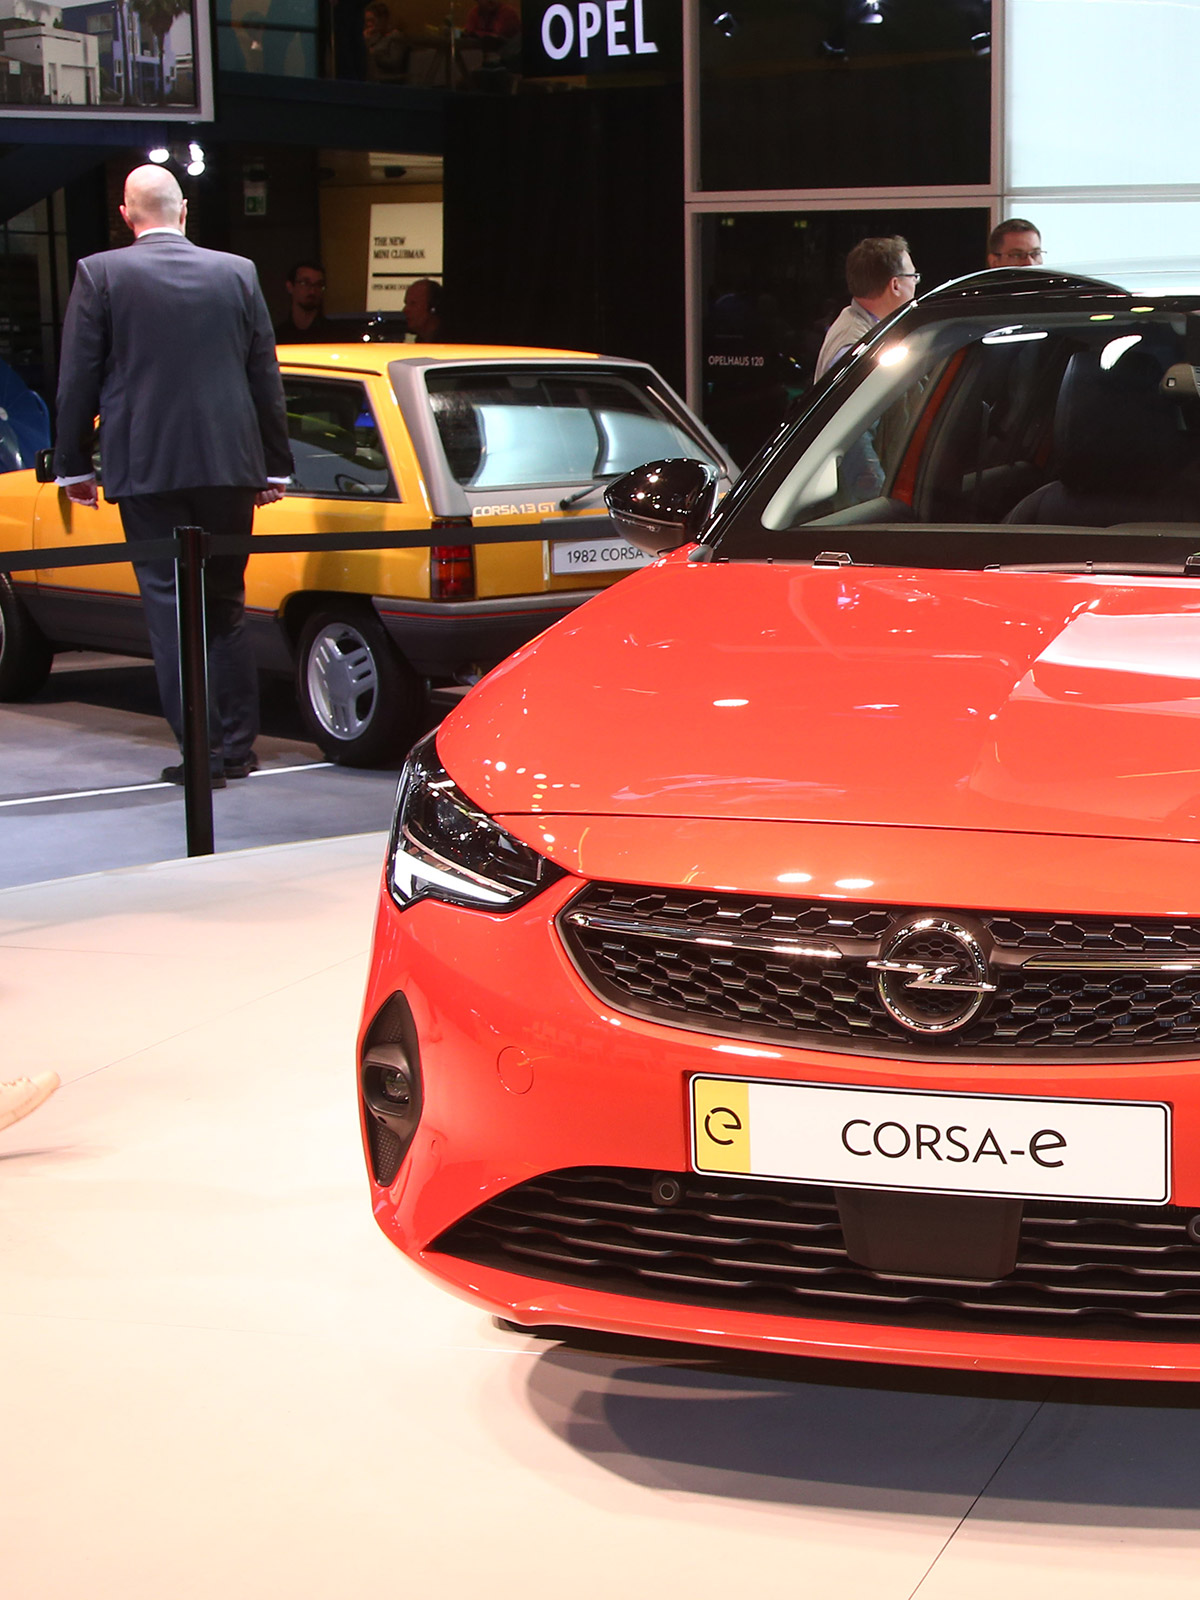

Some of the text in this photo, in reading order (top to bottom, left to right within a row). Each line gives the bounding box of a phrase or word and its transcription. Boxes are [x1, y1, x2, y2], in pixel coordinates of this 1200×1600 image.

[541, 0, 658, 60] OPEL
[389, 236, 406, 246] NEW
[708, 355, 764, 366] OPELHAUS 120
[472, 504, 520, 517] CORSA
[537, 501, 557, 513] GT
[567, 549, 598, 564] 1982
[600, 547, 645, 562] CORSA
[704, 1107, 1068, 1168] e CORSA-e
